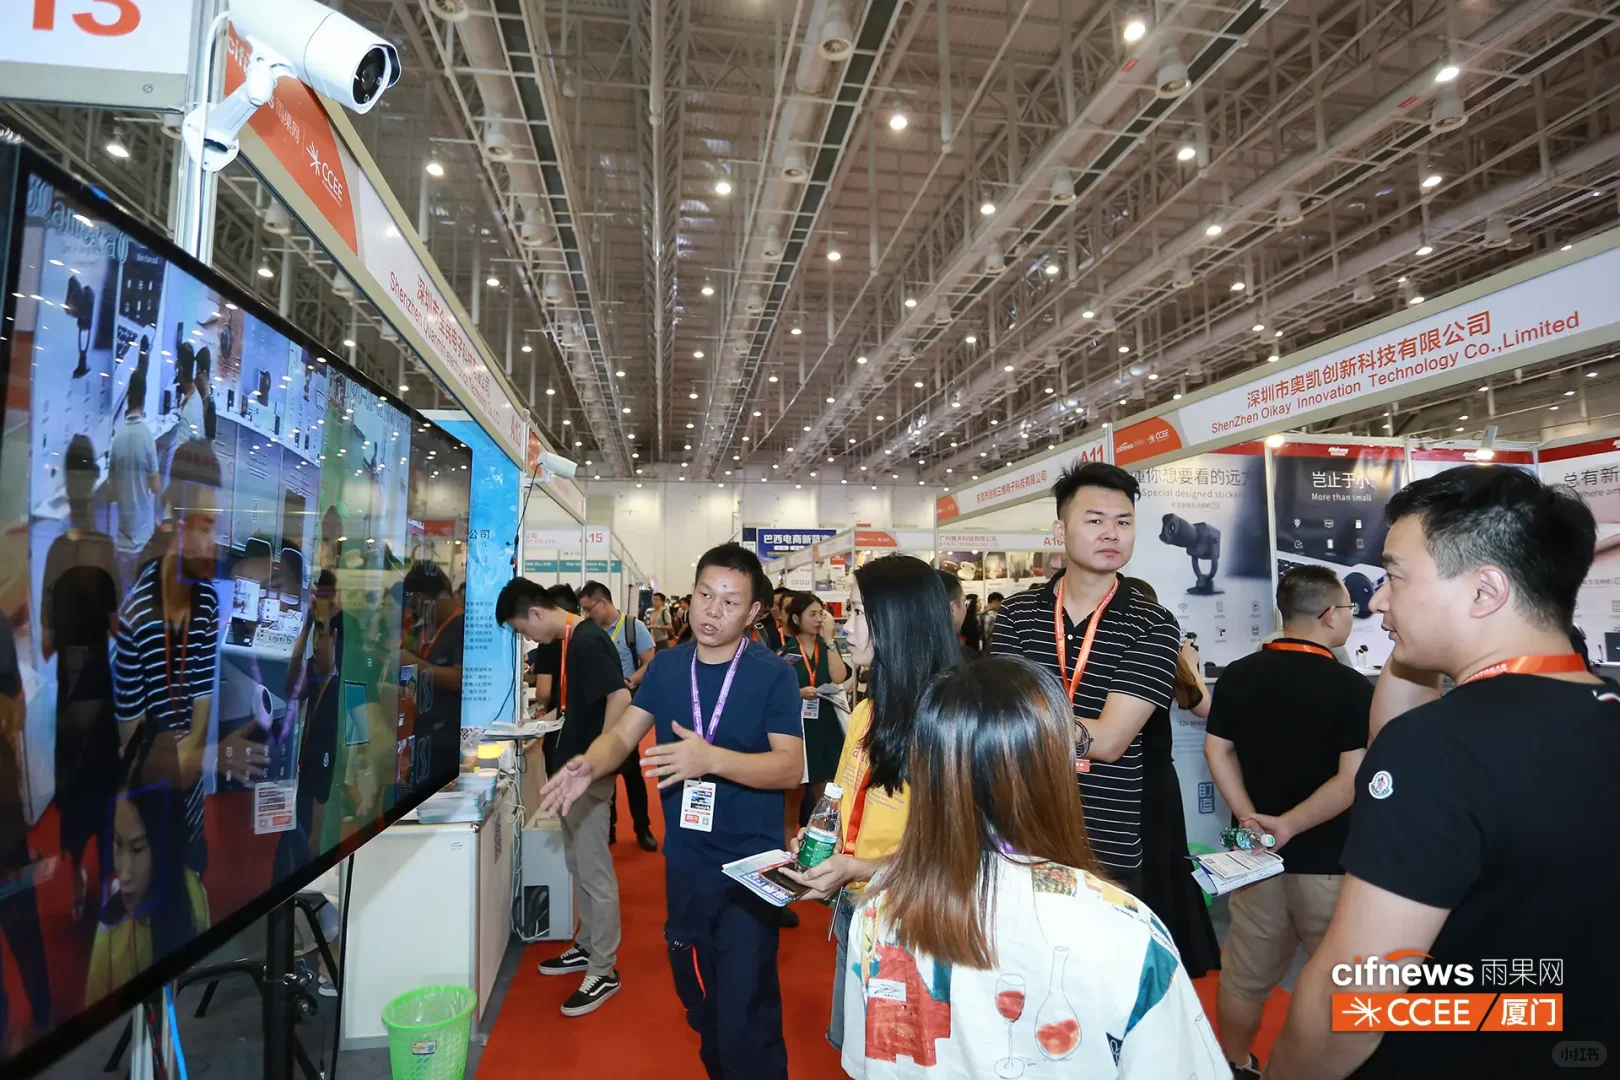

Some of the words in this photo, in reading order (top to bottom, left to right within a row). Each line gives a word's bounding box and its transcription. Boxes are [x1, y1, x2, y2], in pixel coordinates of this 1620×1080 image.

[321, 162, 344, 202] CCEE
[1247, 311, 1491, 409] 深圳市奥凯创新科技有限公司
[1211, 412, 1259, 434] ShenZhen
[1261, 403, 1292, 421] Oikay
[1297, 380, 1361, 409] Innovation
[1369, 351, 1459, 388] Technology
[1464, 311, 1580, 360] Co.,Limited
[1081, 445, 1104, 464] A11
[1312, 471, 1370, 489] 岂止于小
[1564, 465, 1619, 489] 总有新
[1142, 488, 1173, 498] Special
[1175, 488, 1213, 500] designed
[1311, 493, 1331, 501] More
[1332, 493, 1351, 501] than
[1352, 494, 1372, 502] small
[469, 529, 490, 540] 公司
